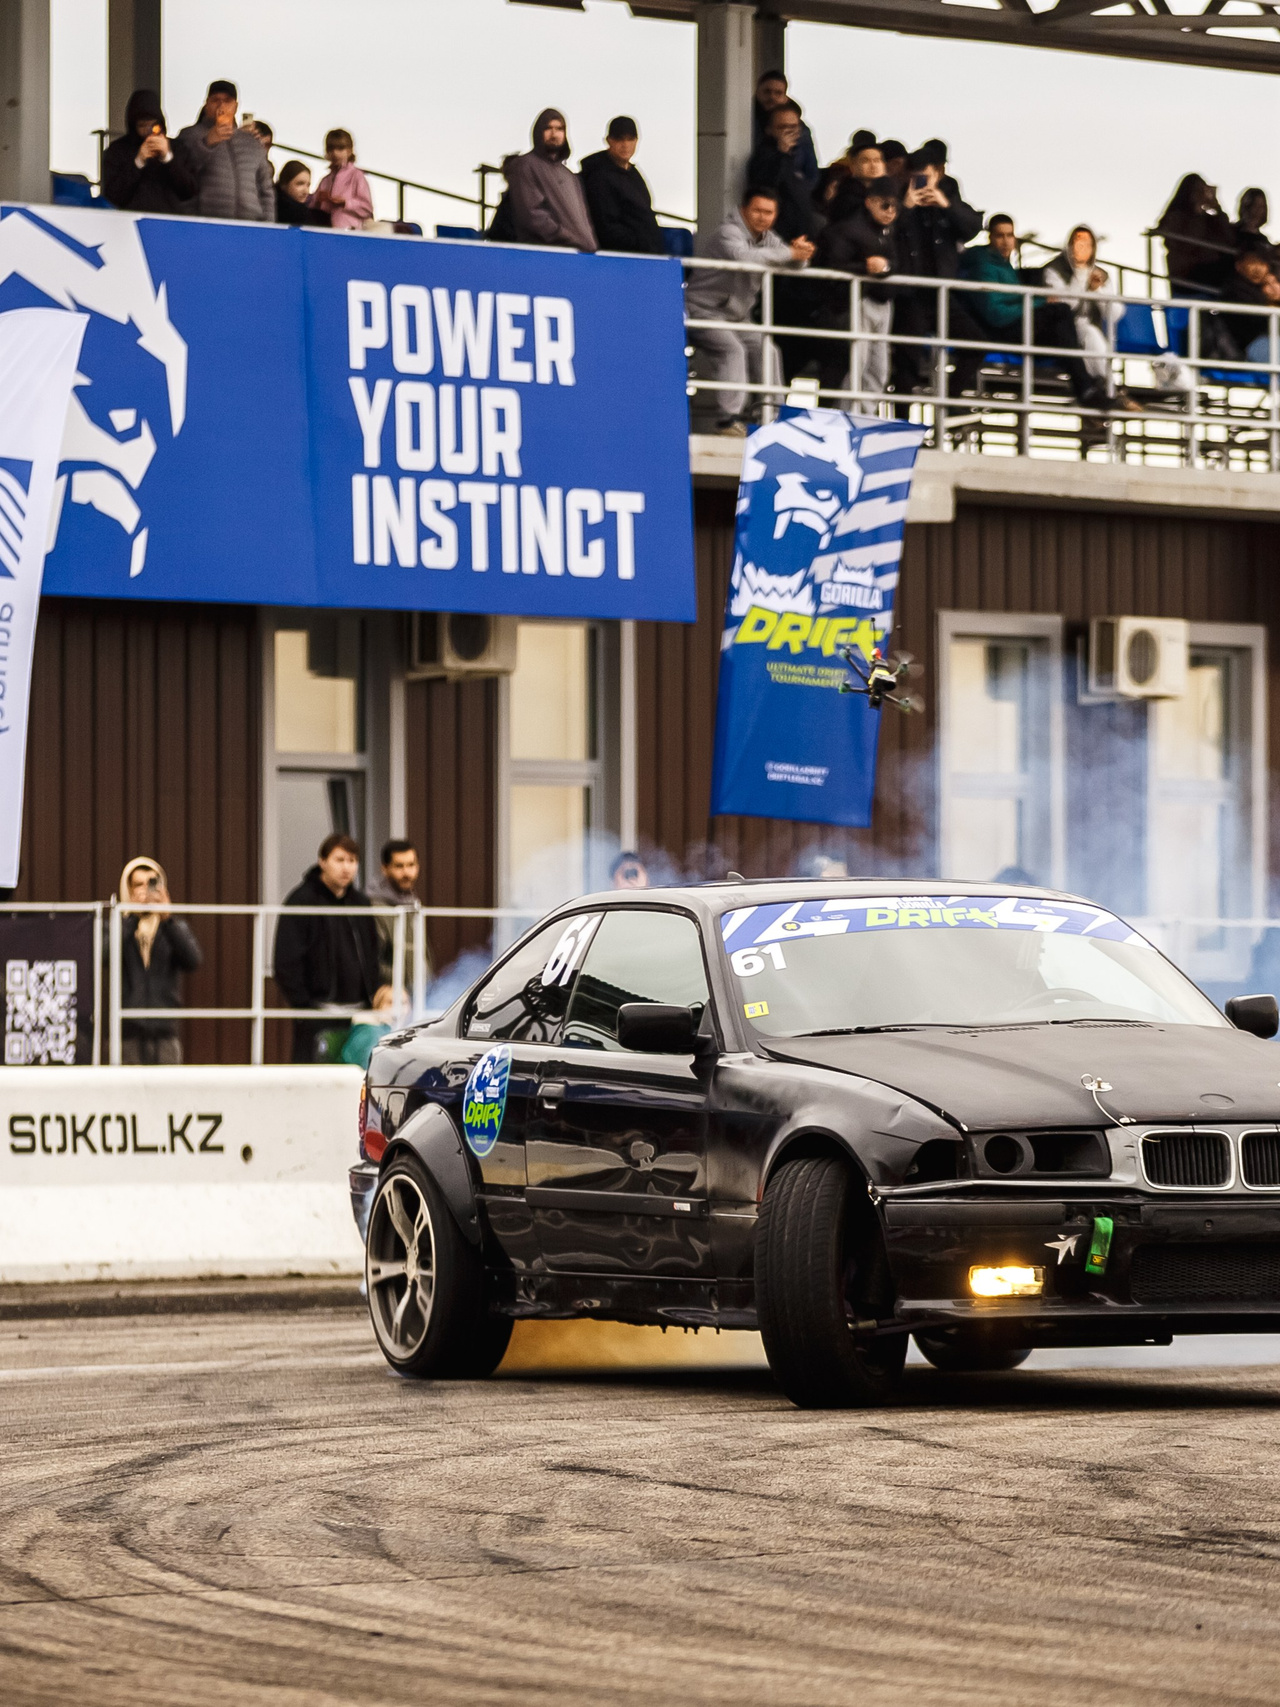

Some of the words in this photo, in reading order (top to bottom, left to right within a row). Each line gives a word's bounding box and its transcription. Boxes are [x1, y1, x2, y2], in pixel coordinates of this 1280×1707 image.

[347, 279, 576, 386] POWER
[348, 376, 523, 478] YOUR
[351, 473, 645, 580] INSTINCT
[820, 582, 883, 610] GORILLA
[734, 605, 885, 664] DRIFT
[866, 908, 999, 928] DRIFT
[541, 915, 602, 986] 61
[730, 942, 787, 978] 61
[9, 1114, 224, 1154] SOKOL.KZ
[465, 1101, 501, 1130] DRIFT
